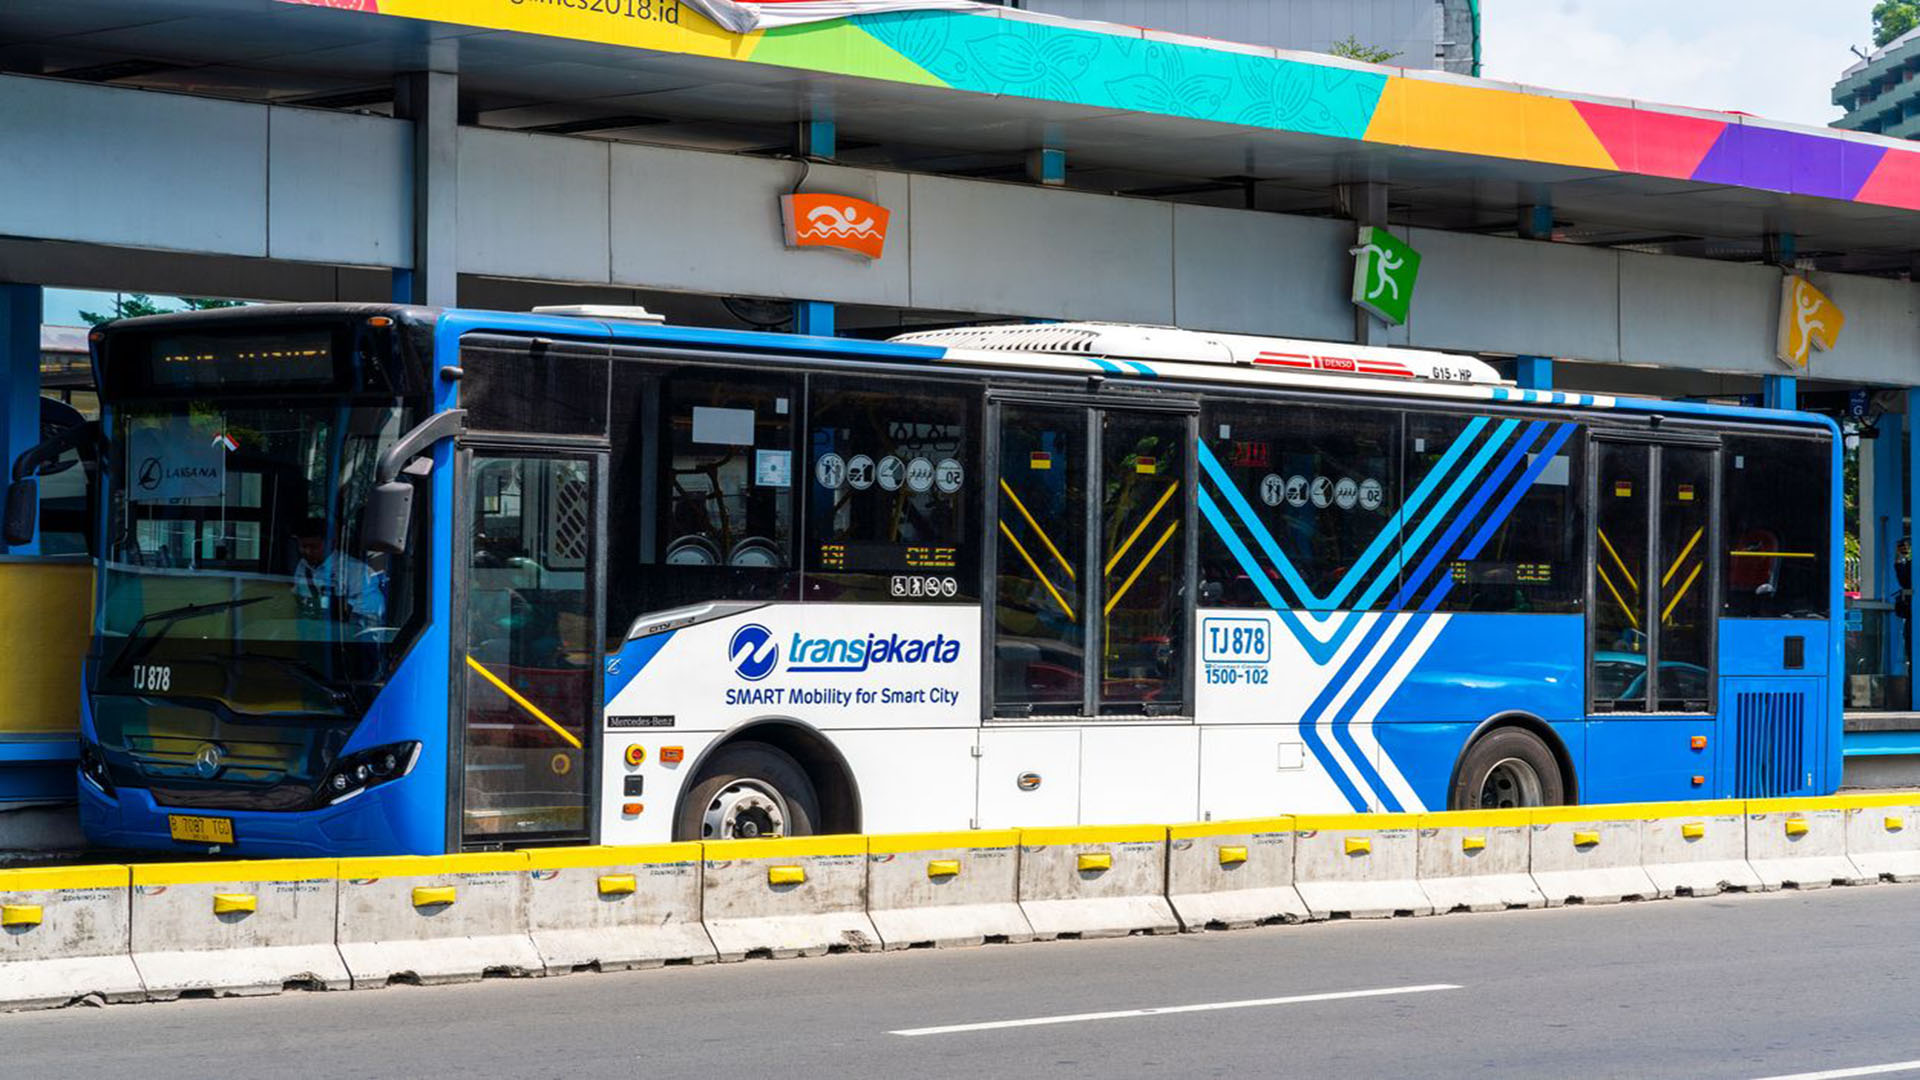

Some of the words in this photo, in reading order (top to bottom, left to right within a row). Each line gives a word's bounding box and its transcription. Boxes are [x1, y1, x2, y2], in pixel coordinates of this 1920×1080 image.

[1324, 359, 1352, 368] DENSO
[1432, 366, 1451, 379] G15
[1458, 368, 1472, 380] HP
[1210, 627, 1229, 654] TJ
[1232, 627, 1265, 655] 878
[787, 632, 961, 672] transjakarta
[133, 665, 146, 689] TJ
[147, 665, 171, 691] 878
[1205, 669, 1269, 684] 1500-102
[726, 688, 785, 705] SMART
[788, 688, 852, 708] Mobility
[856, 688, 878, 704] for
[881, 687, 926, 704] Smart
[929, 687, 959, 706] City
[610, 717, 673, 726] Mercedes-Benz
